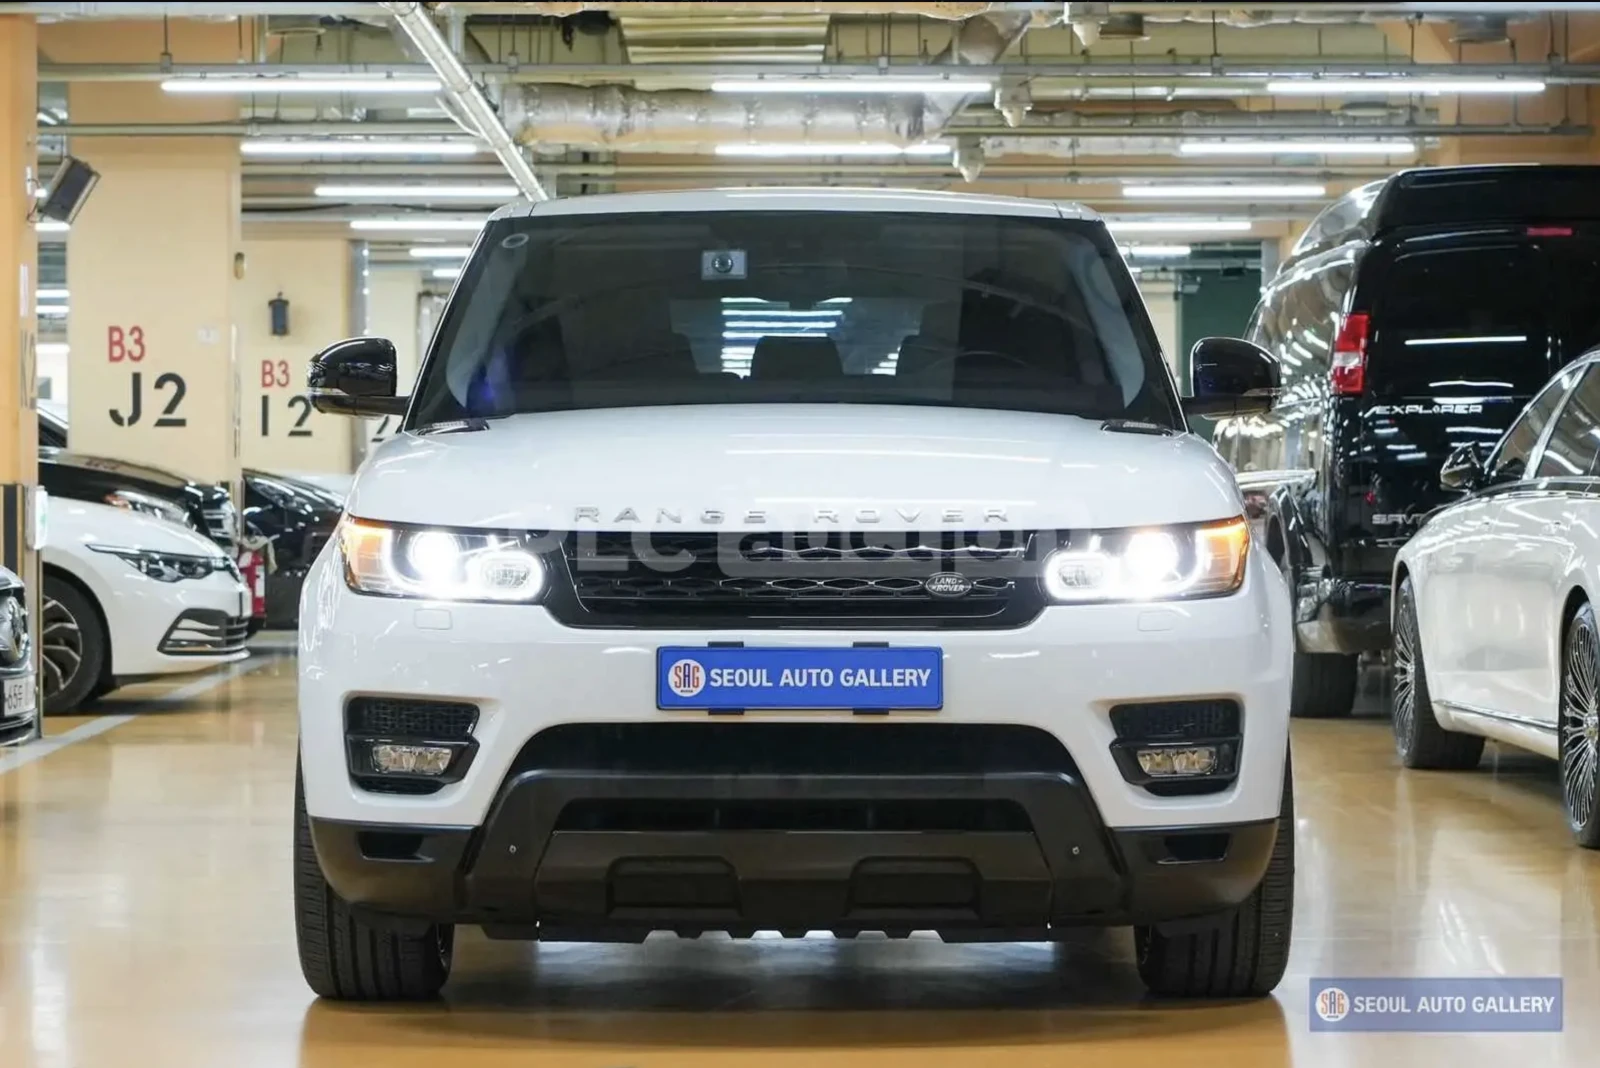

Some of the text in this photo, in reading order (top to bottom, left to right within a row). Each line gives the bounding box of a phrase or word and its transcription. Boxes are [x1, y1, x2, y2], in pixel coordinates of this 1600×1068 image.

[108, 325, 145, 363] B3
[261, 359, 290, 388] B3
[574, 507, 1009, 524] RANGE ROVER
[934, 577, 958, 585] LAND
[936, 584, 965, 592] ROVER
[674, 663, 932, 689] SAG SEOUL AUTO GALLERY
